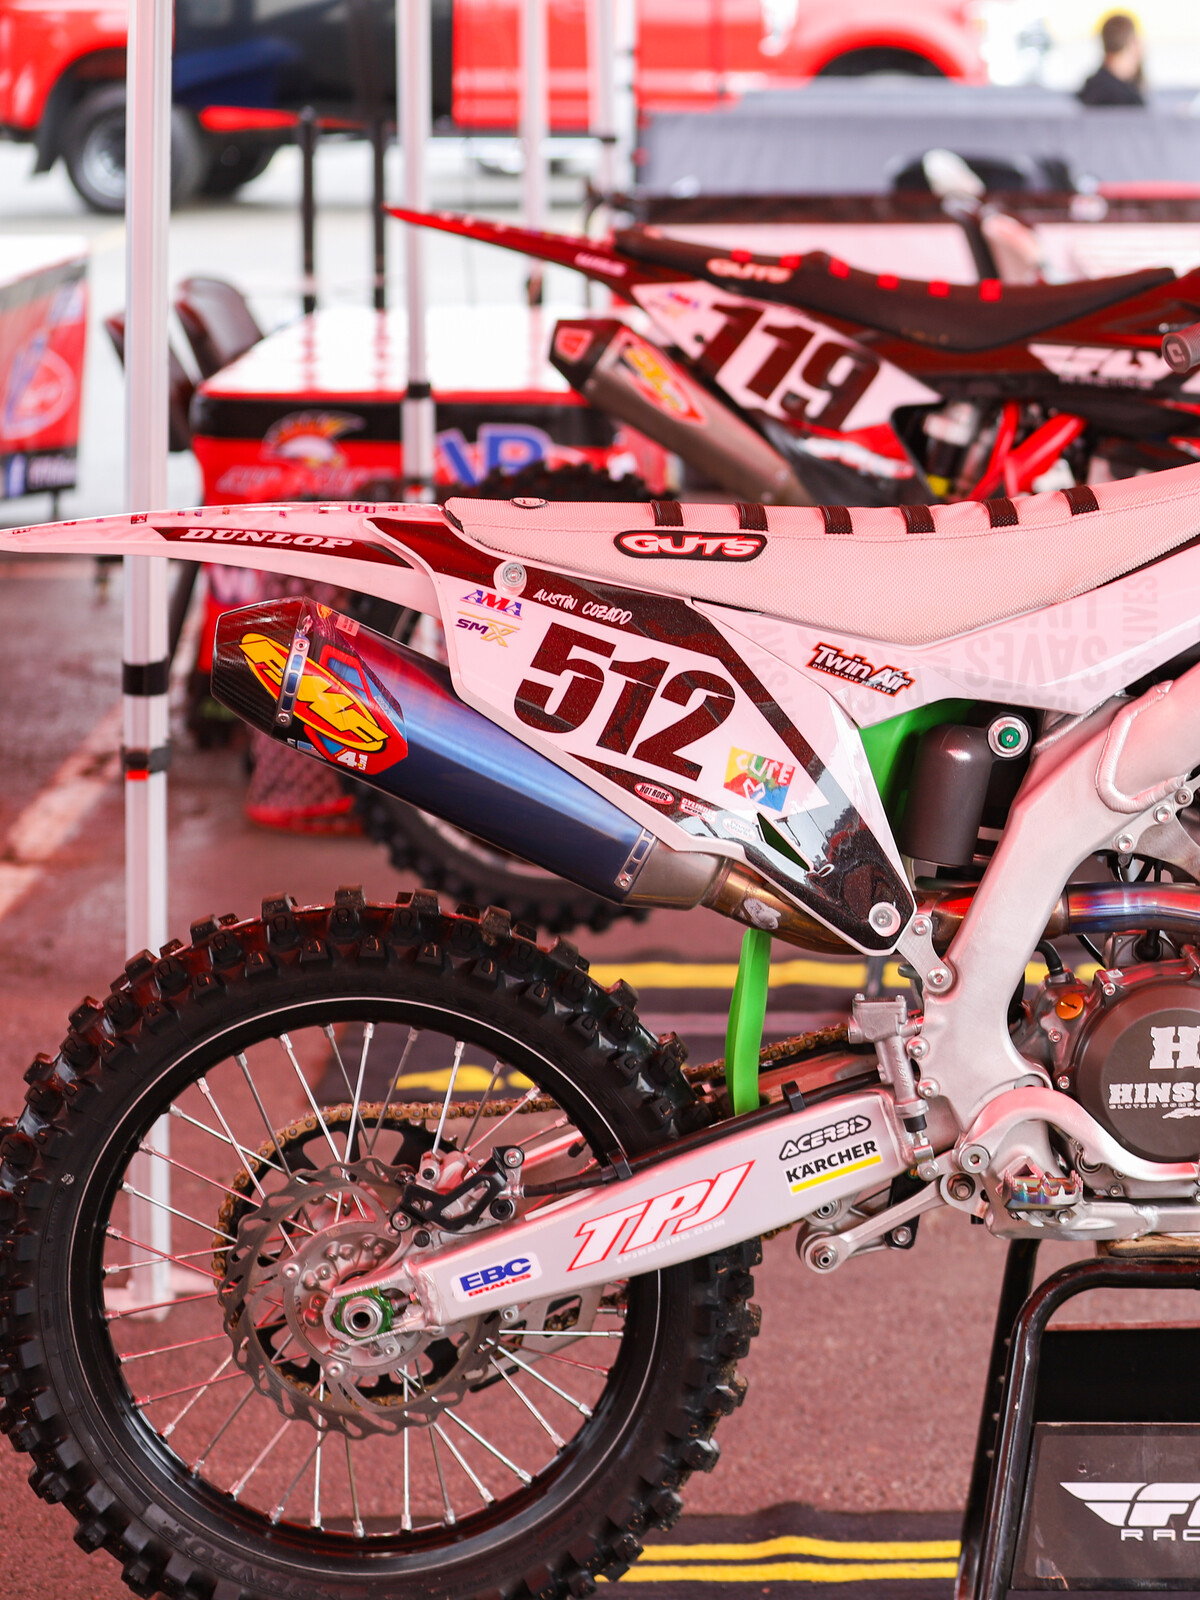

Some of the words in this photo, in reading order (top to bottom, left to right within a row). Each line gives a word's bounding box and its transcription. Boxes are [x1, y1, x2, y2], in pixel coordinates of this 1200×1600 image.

[697, 303, 882, 431] 119
[180, 529, 354, 549] DUNLOP
[619, 533, 761, 557] GUTS
[460, 589, 523, 618] AMA
[533, 589, 577, 610] AUSTIN
[455, 613, 520, 648] SMX
[814, 646, 872, 679] Twin
[867, 667, 910, 691] Air
[514, 622, 736, 782] 512
[786, 1140, 878, 1183] KÄRCHER
[566, 1160, 756, 1272] TPJ
[459, 1257, 532, 1292] EBC
[468, 1273, 532, 1297] BRAKES
